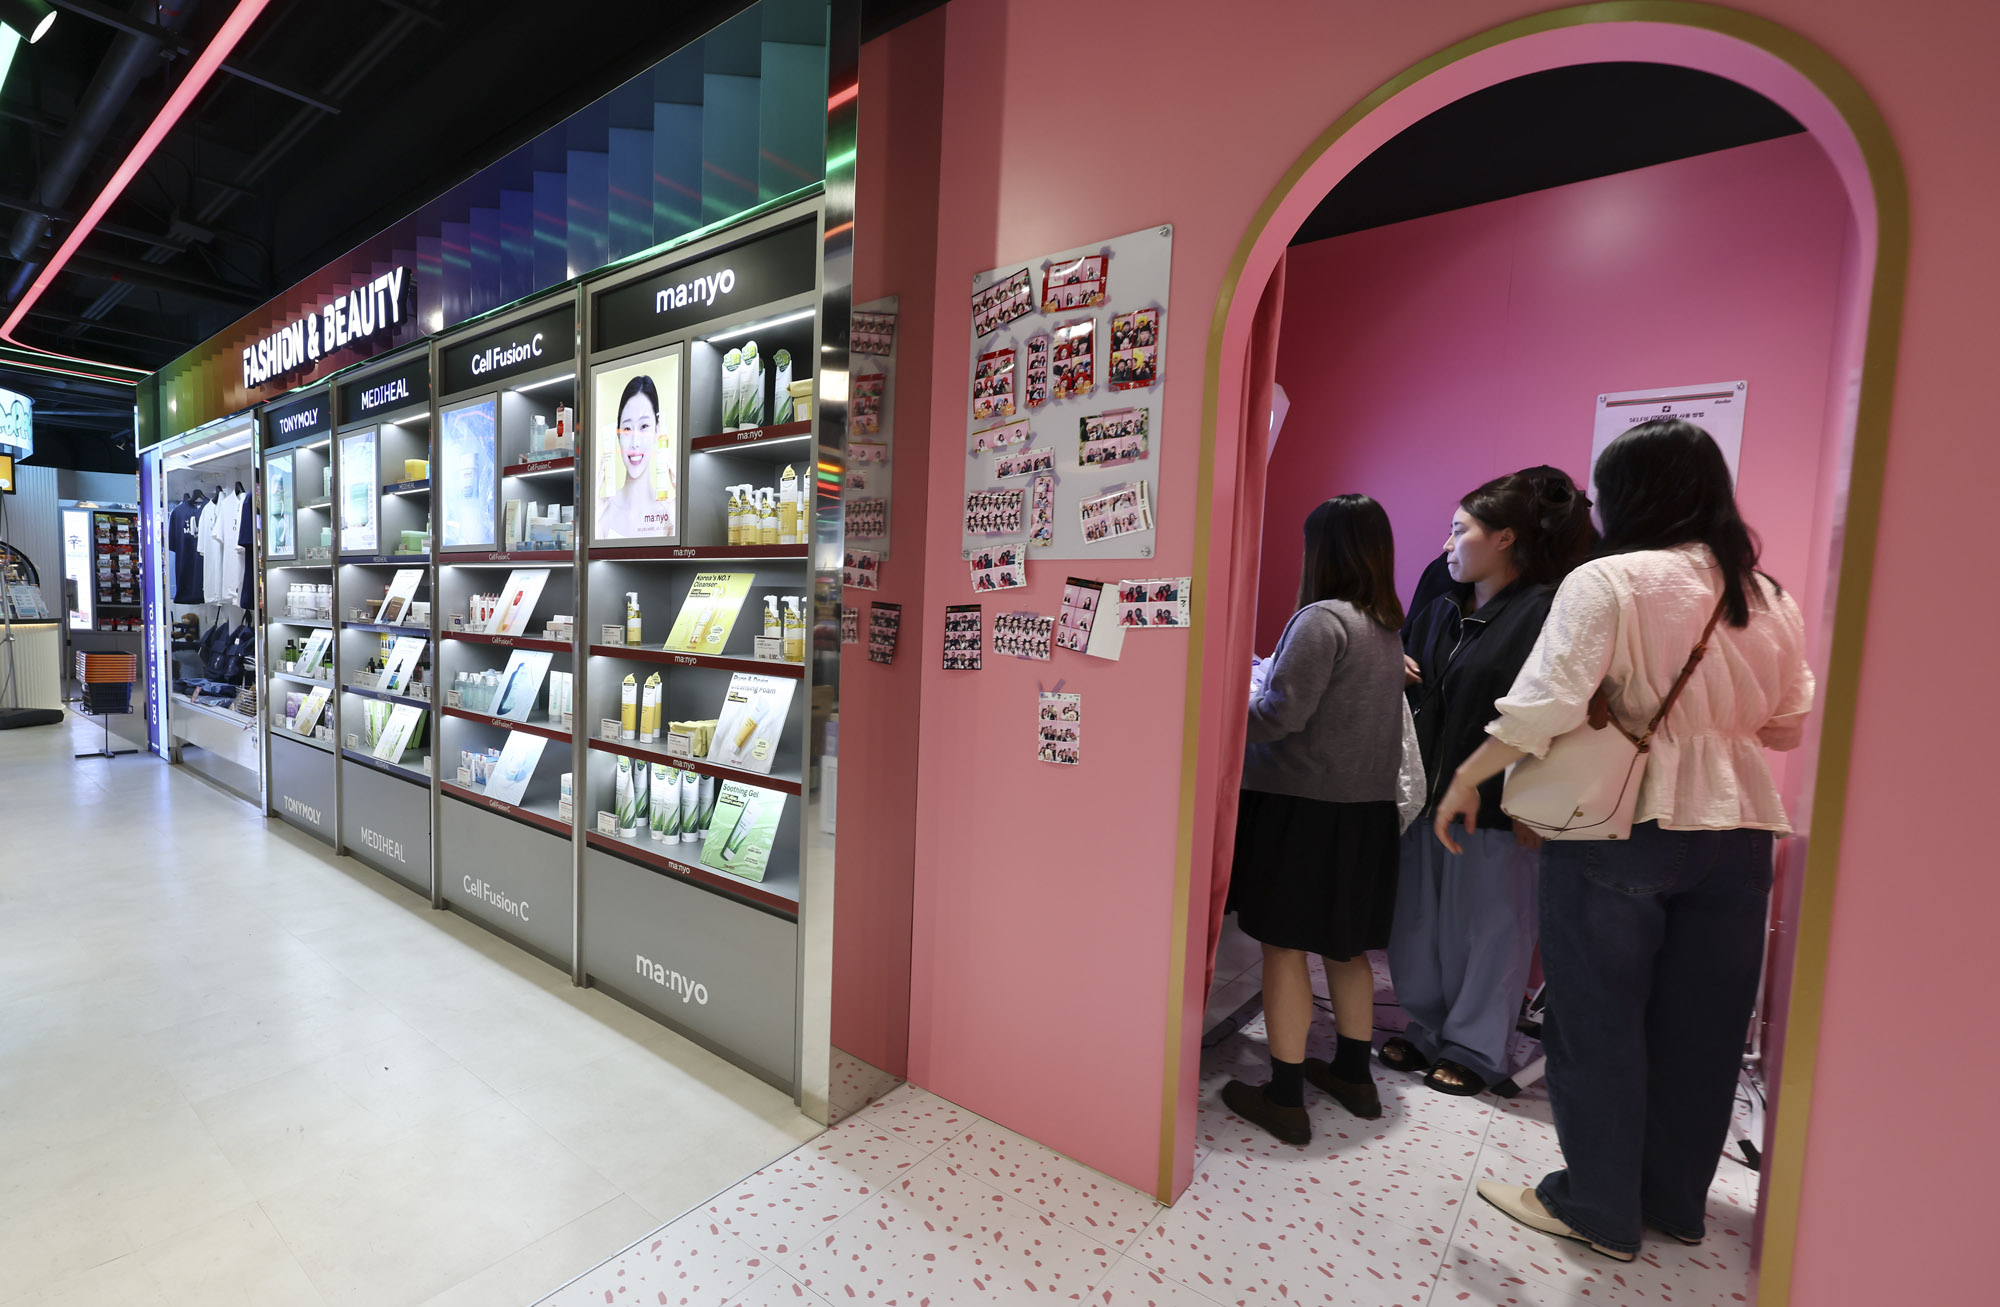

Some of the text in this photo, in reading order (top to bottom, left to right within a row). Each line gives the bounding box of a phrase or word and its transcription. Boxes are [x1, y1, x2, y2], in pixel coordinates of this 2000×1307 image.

[656, 269, 735, 314] ma:nyo
[243, 266, 404, 389] FASHION & BEAUTY
[471, 333, 544, 375] Cell Fusion C
[361, 378, 409, 410] MEDIHEAL
[279, 408, 319, 434] TONYMOLY
[737, 429, 763, 441] ma:nyo
[527, 464, 535, 472] Cell
[535, 462, 547, 471] Fusion
[644, 513, 669, 523] ma:nyo
[673, 548, 696, 559] ma:nyo
[149, 602, 154, 620] TO
[492, 637, 500, 645] Cell
[674, 655, 697, 665] ma:nyo
[151, 666, 156, 678] IS
[151, 682, 157, 700] TO
[152, 705, 158, 725] DO
[492, 718, 500, 727] Cell
[500, 720, 510, 729] Fusion
[673, 758, 695, 771] ma:nyo
[723, 783, 759, 798] Soothing Gel
[284, 795, 321, 826] TONYMOLY
[361, 826, 406, 863] MEDIHEAL
[668, 860, 691, 875] ma:nyo
[463, 874, 529, 921] Cell Fusion C
[636, 953, 708, 1005] ma:nyo
